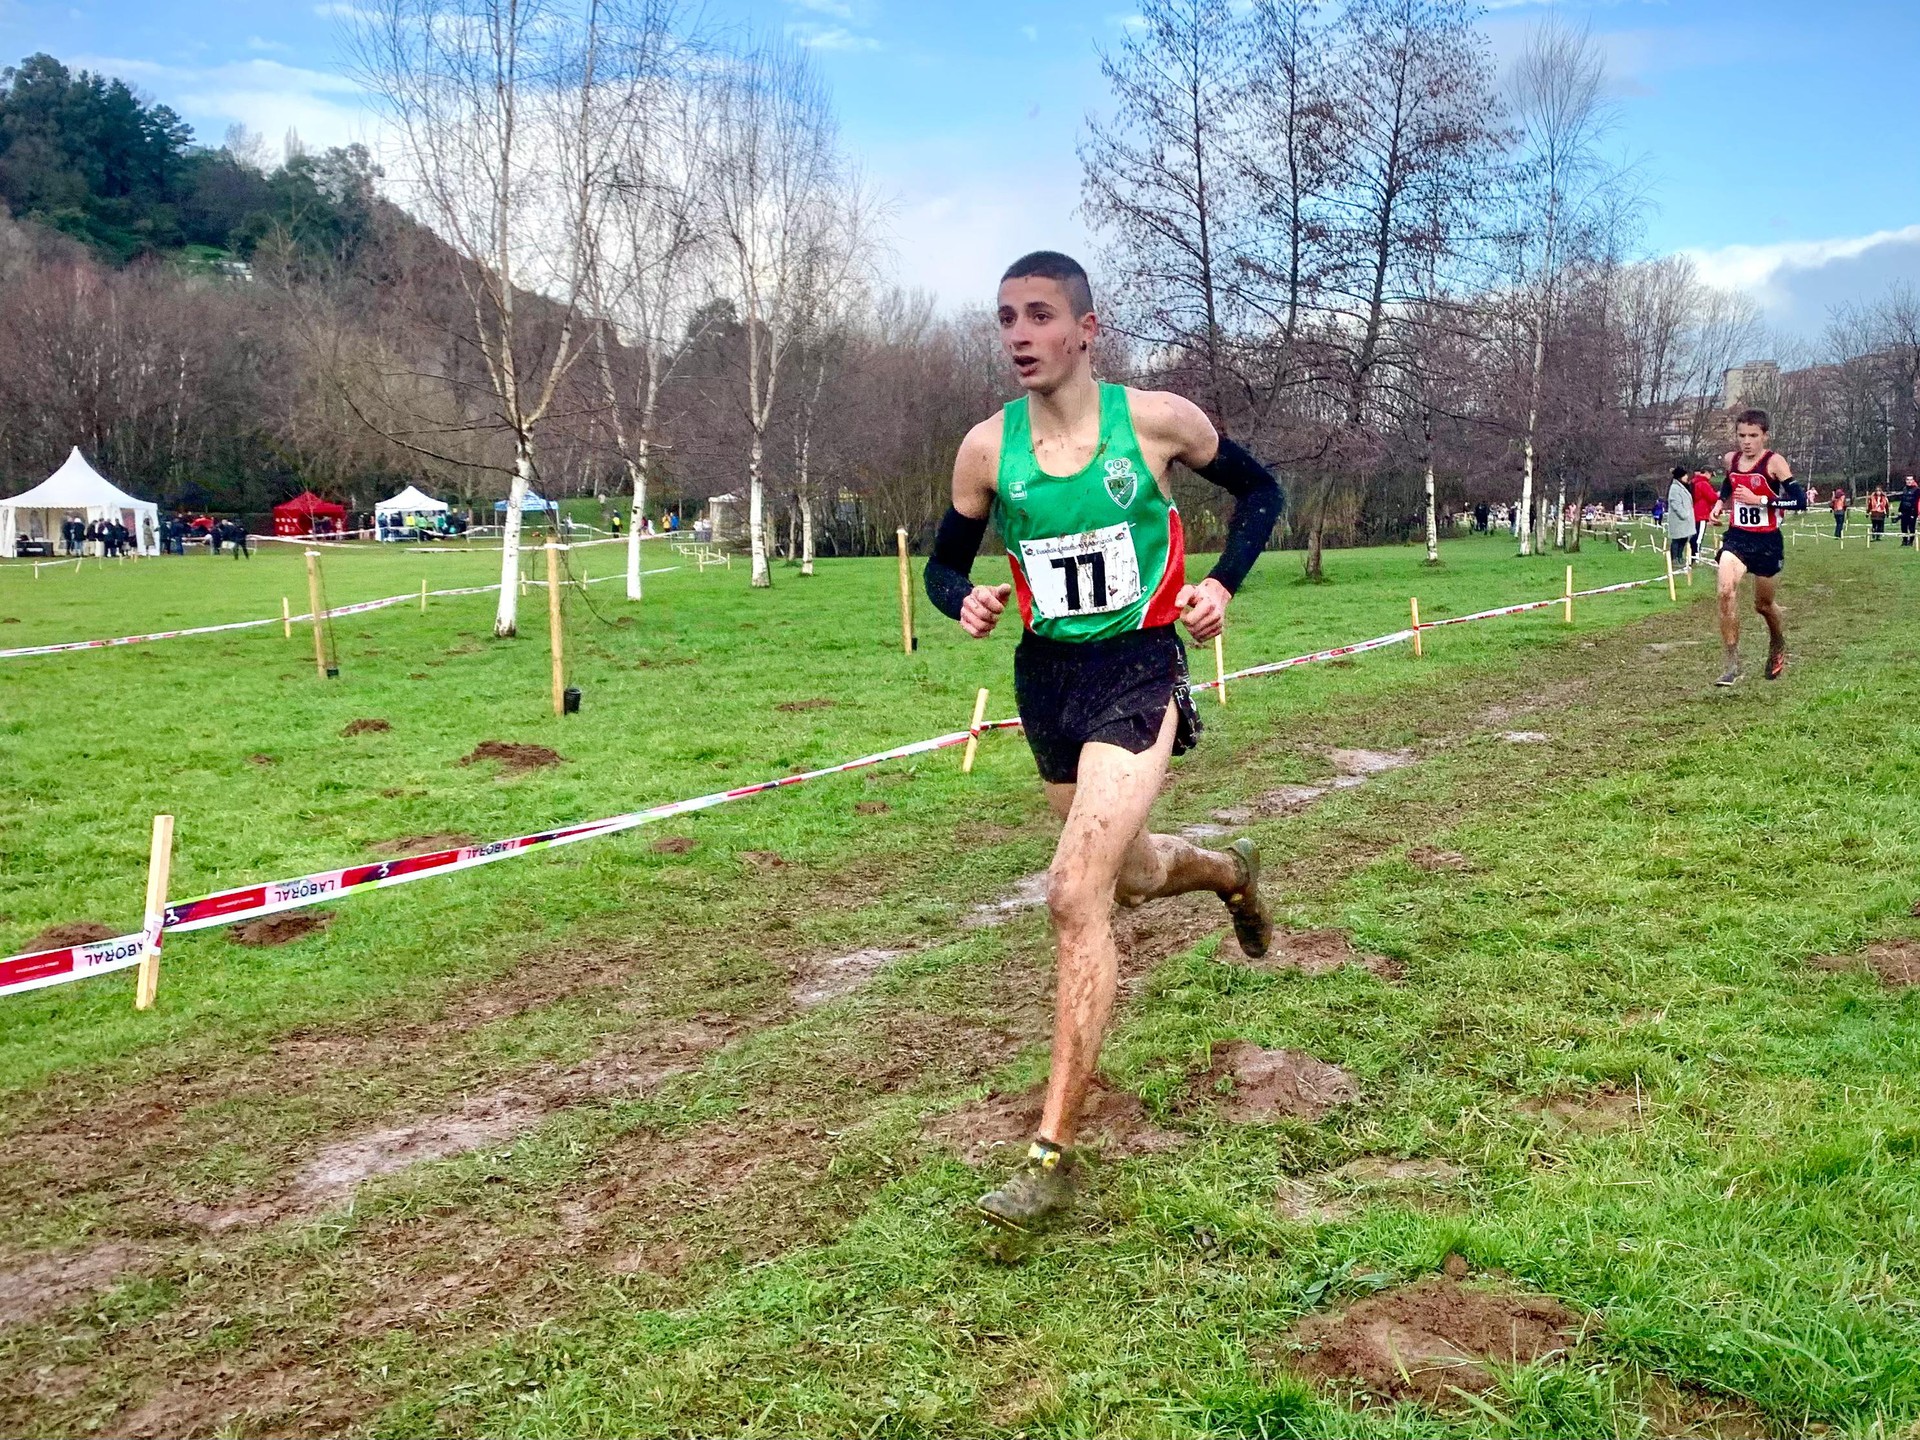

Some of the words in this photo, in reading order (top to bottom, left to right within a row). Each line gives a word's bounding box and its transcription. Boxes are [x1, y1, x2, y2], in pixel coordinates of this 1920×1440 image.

[1739, 507, 1761, 525] 88
[1049, 551, 1107, 611] 77
[466, 840, 516, 860] LABORAL
[274, 880, 335, 902] LABORAL
